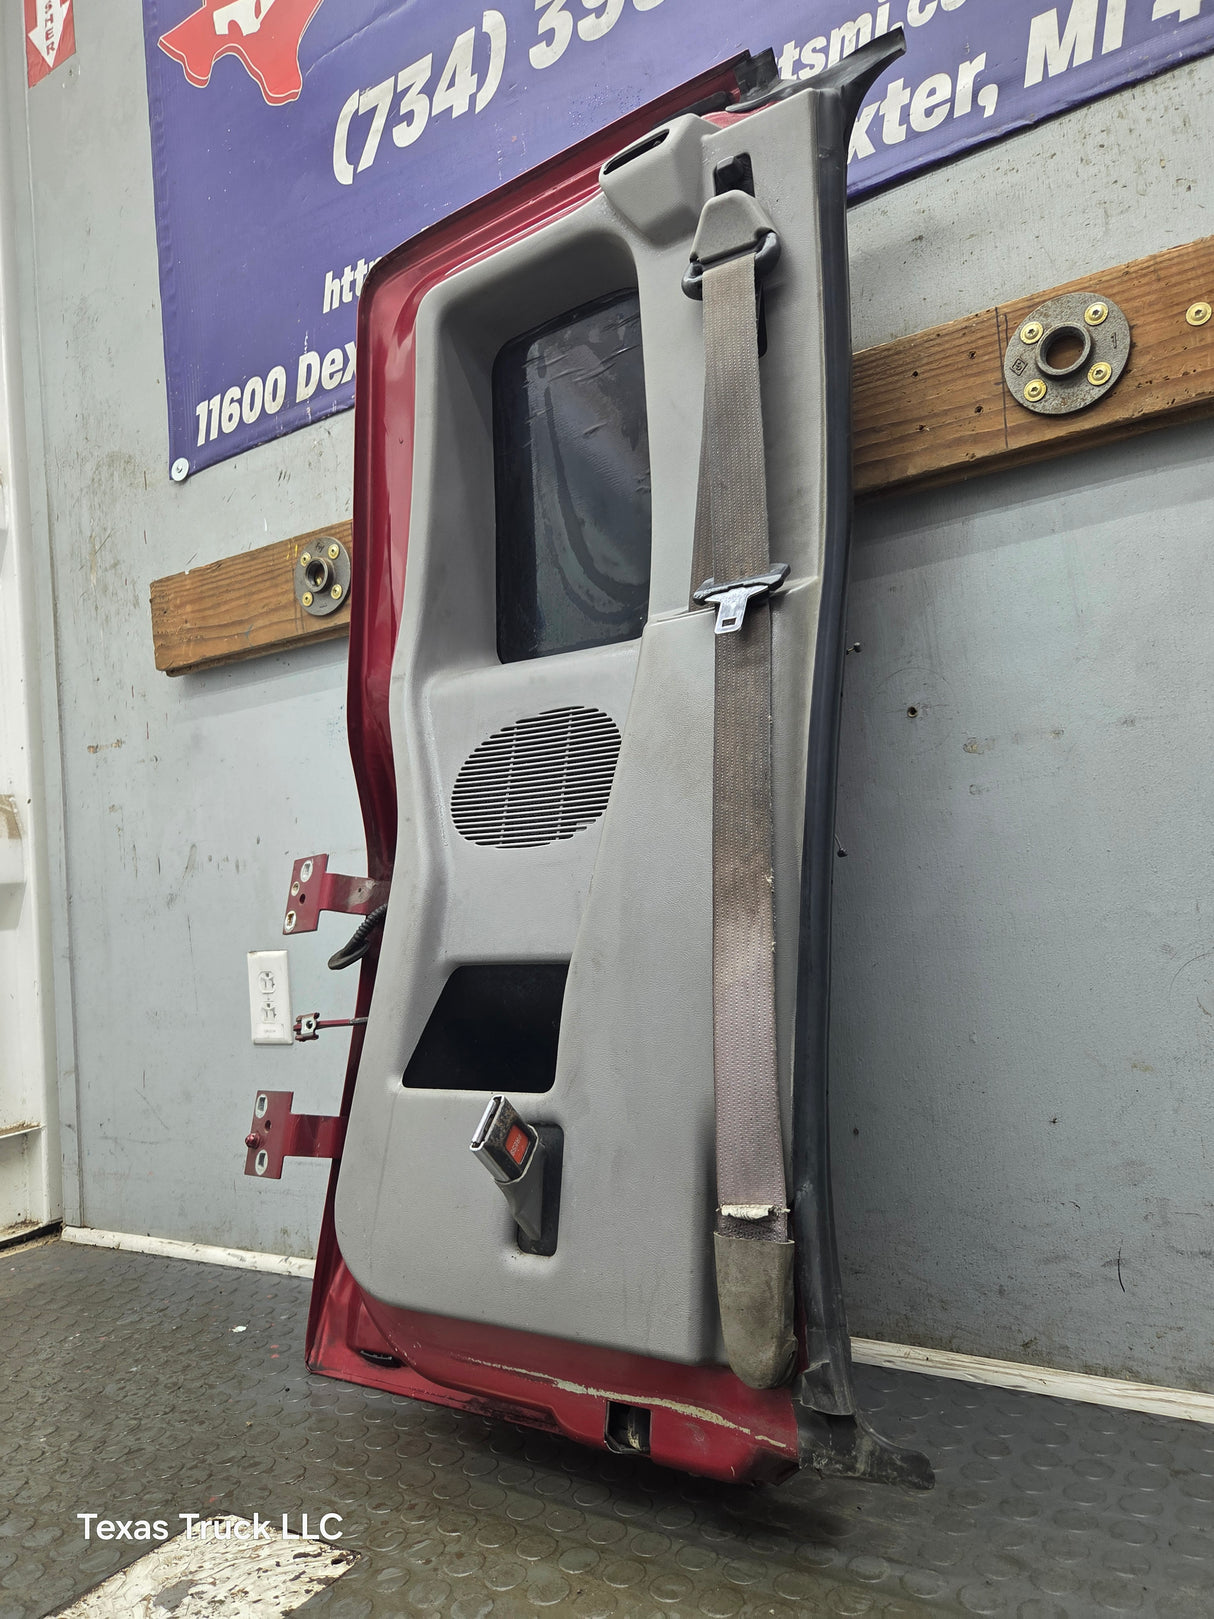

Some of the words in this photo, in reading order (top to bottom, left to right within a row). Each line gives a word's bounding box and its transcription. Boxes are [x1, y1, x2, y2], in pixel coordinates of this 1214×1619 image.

[45, 0, 55, 55] SHER
[1024, 0, 1127, 88] MI
[333, 10, 507, 185] (734)
[529, 0, 665, 69] 39
[323, 257, 382, 314] htt
[196, 365, 287, 447] 11600
